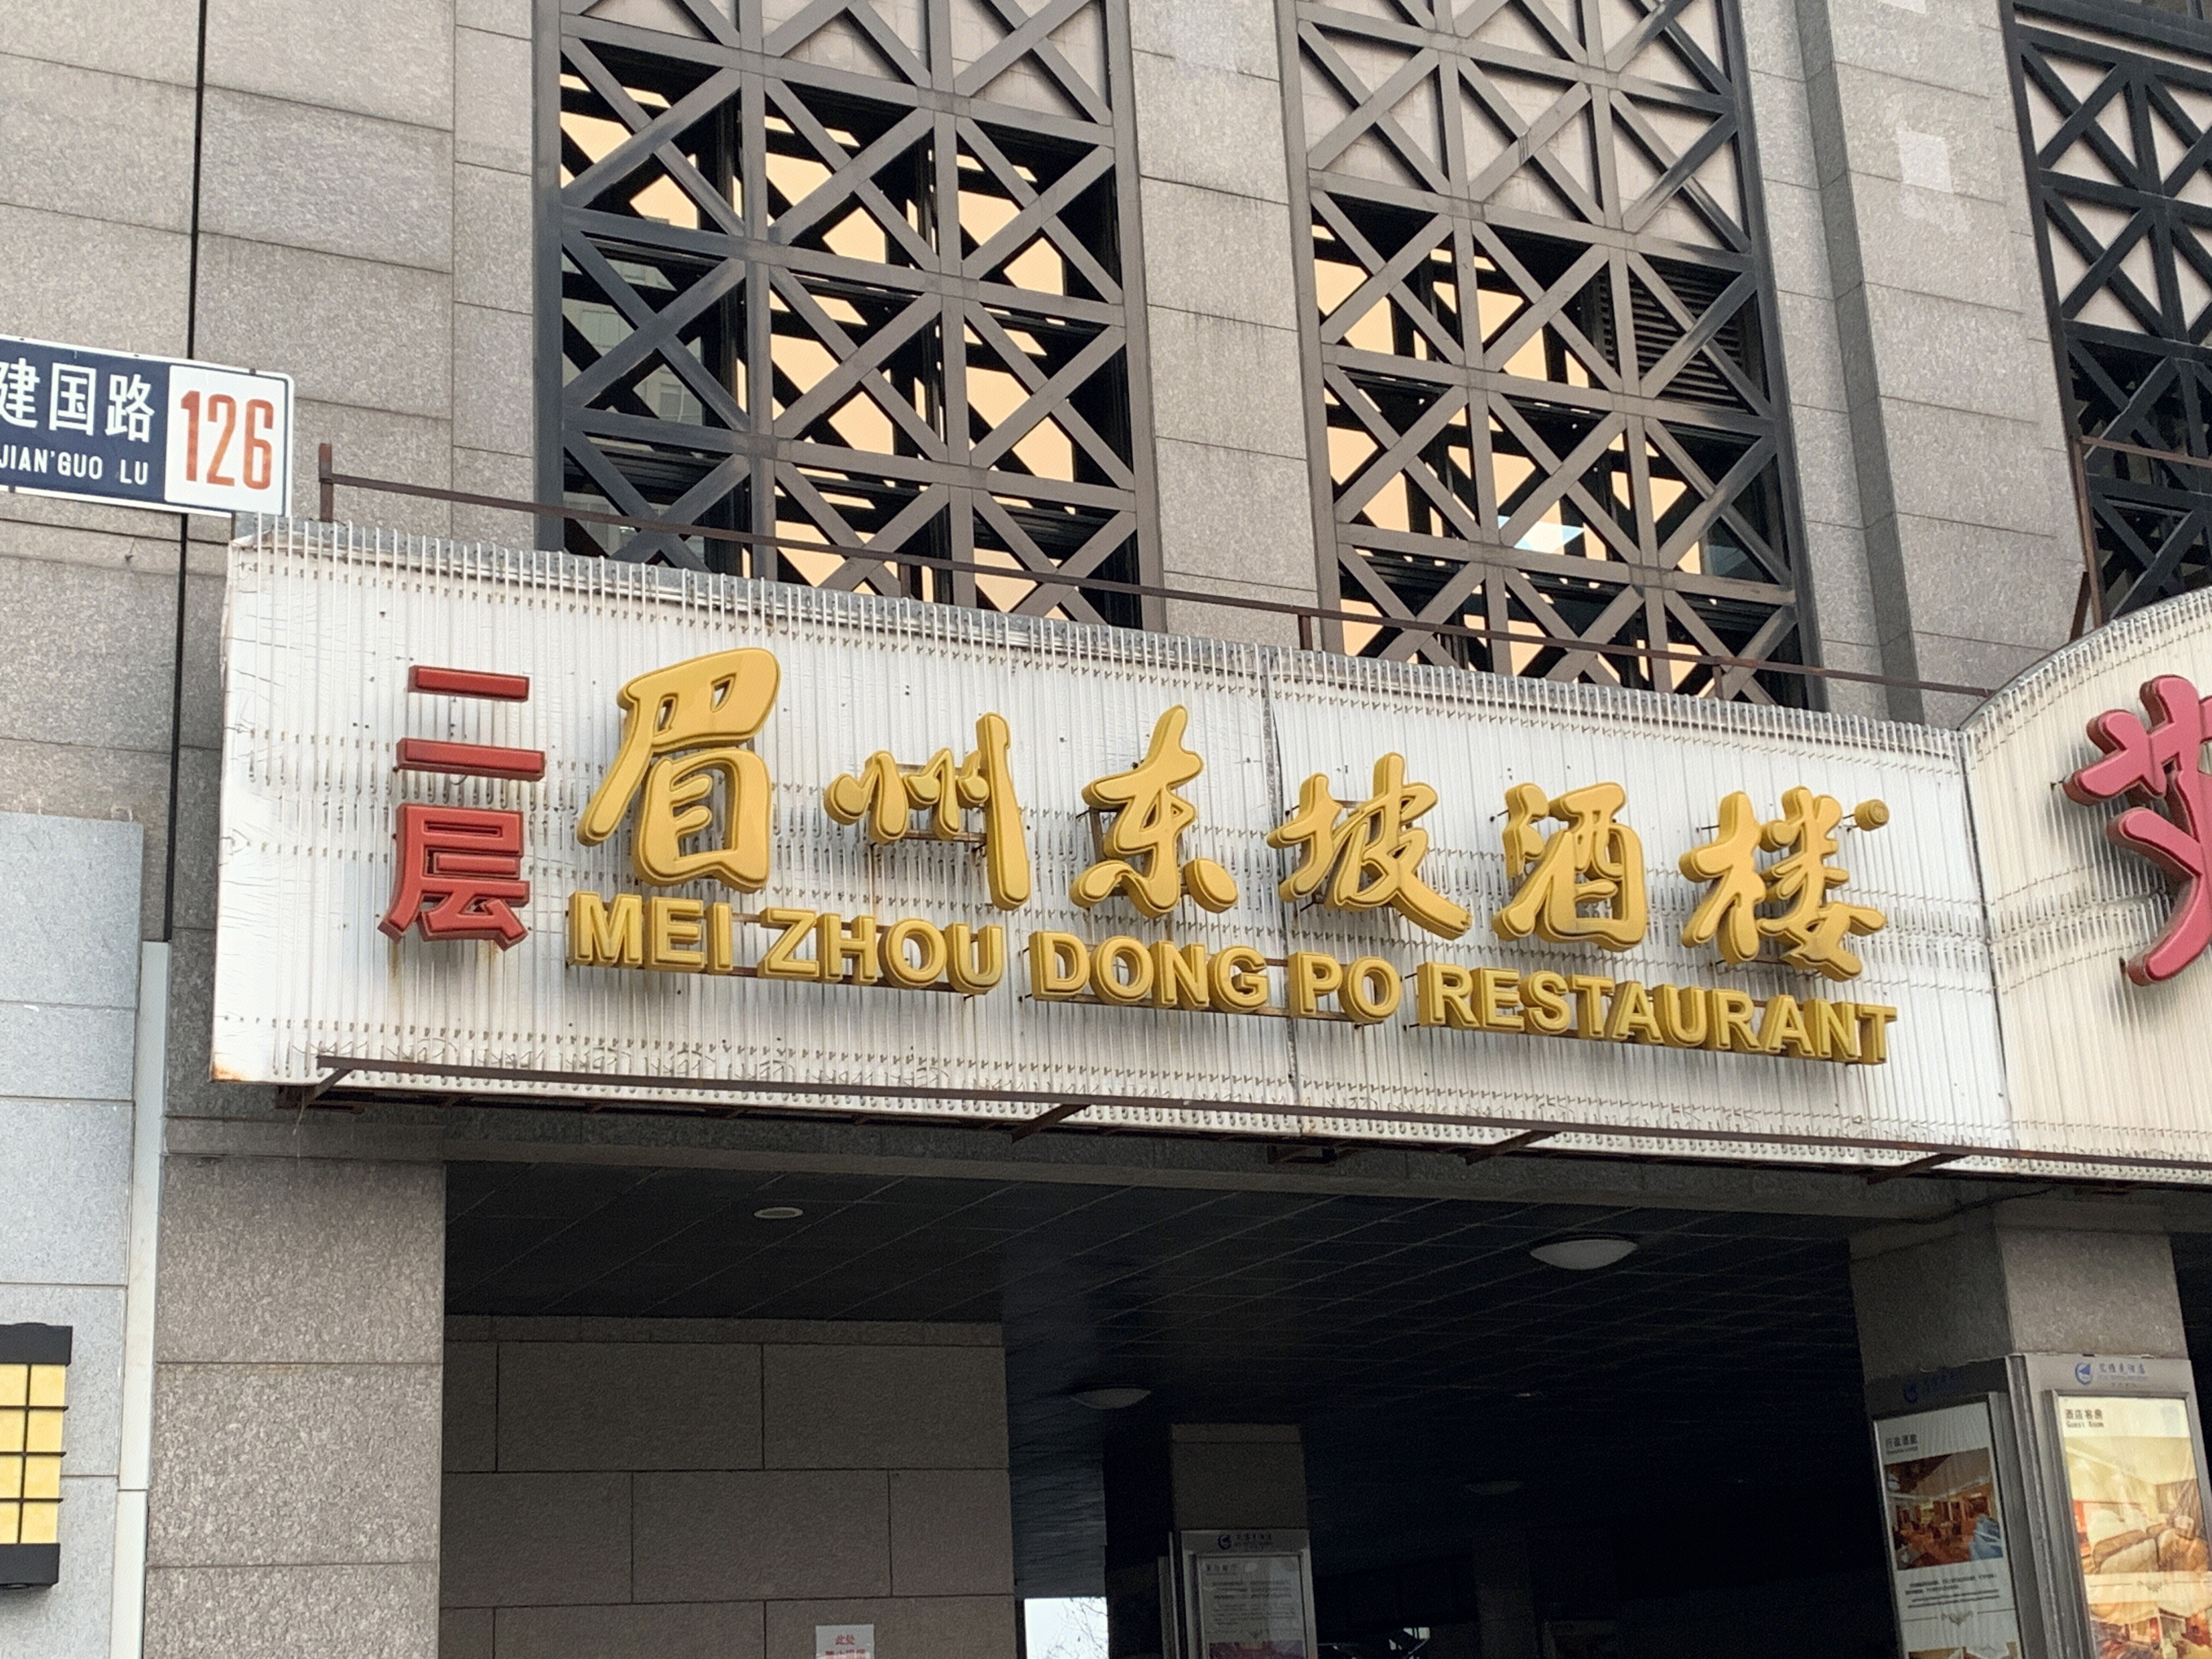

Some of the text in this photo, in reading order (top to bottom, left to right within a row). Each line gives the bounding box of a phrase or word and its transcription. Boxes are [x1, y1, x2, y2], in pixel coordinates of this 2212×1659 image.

[0, 358, 155, 443] 建国路
[180, 390, 274, 489] 126
[120, 459, 149, 485] LU
[378, 665, 545, 951] 二层
[577, 647, 1886, 981] 眉州东坡酒楼
[567, 891, 1898, 1065] MEI ZHOU DONG PO RESTAURANT
